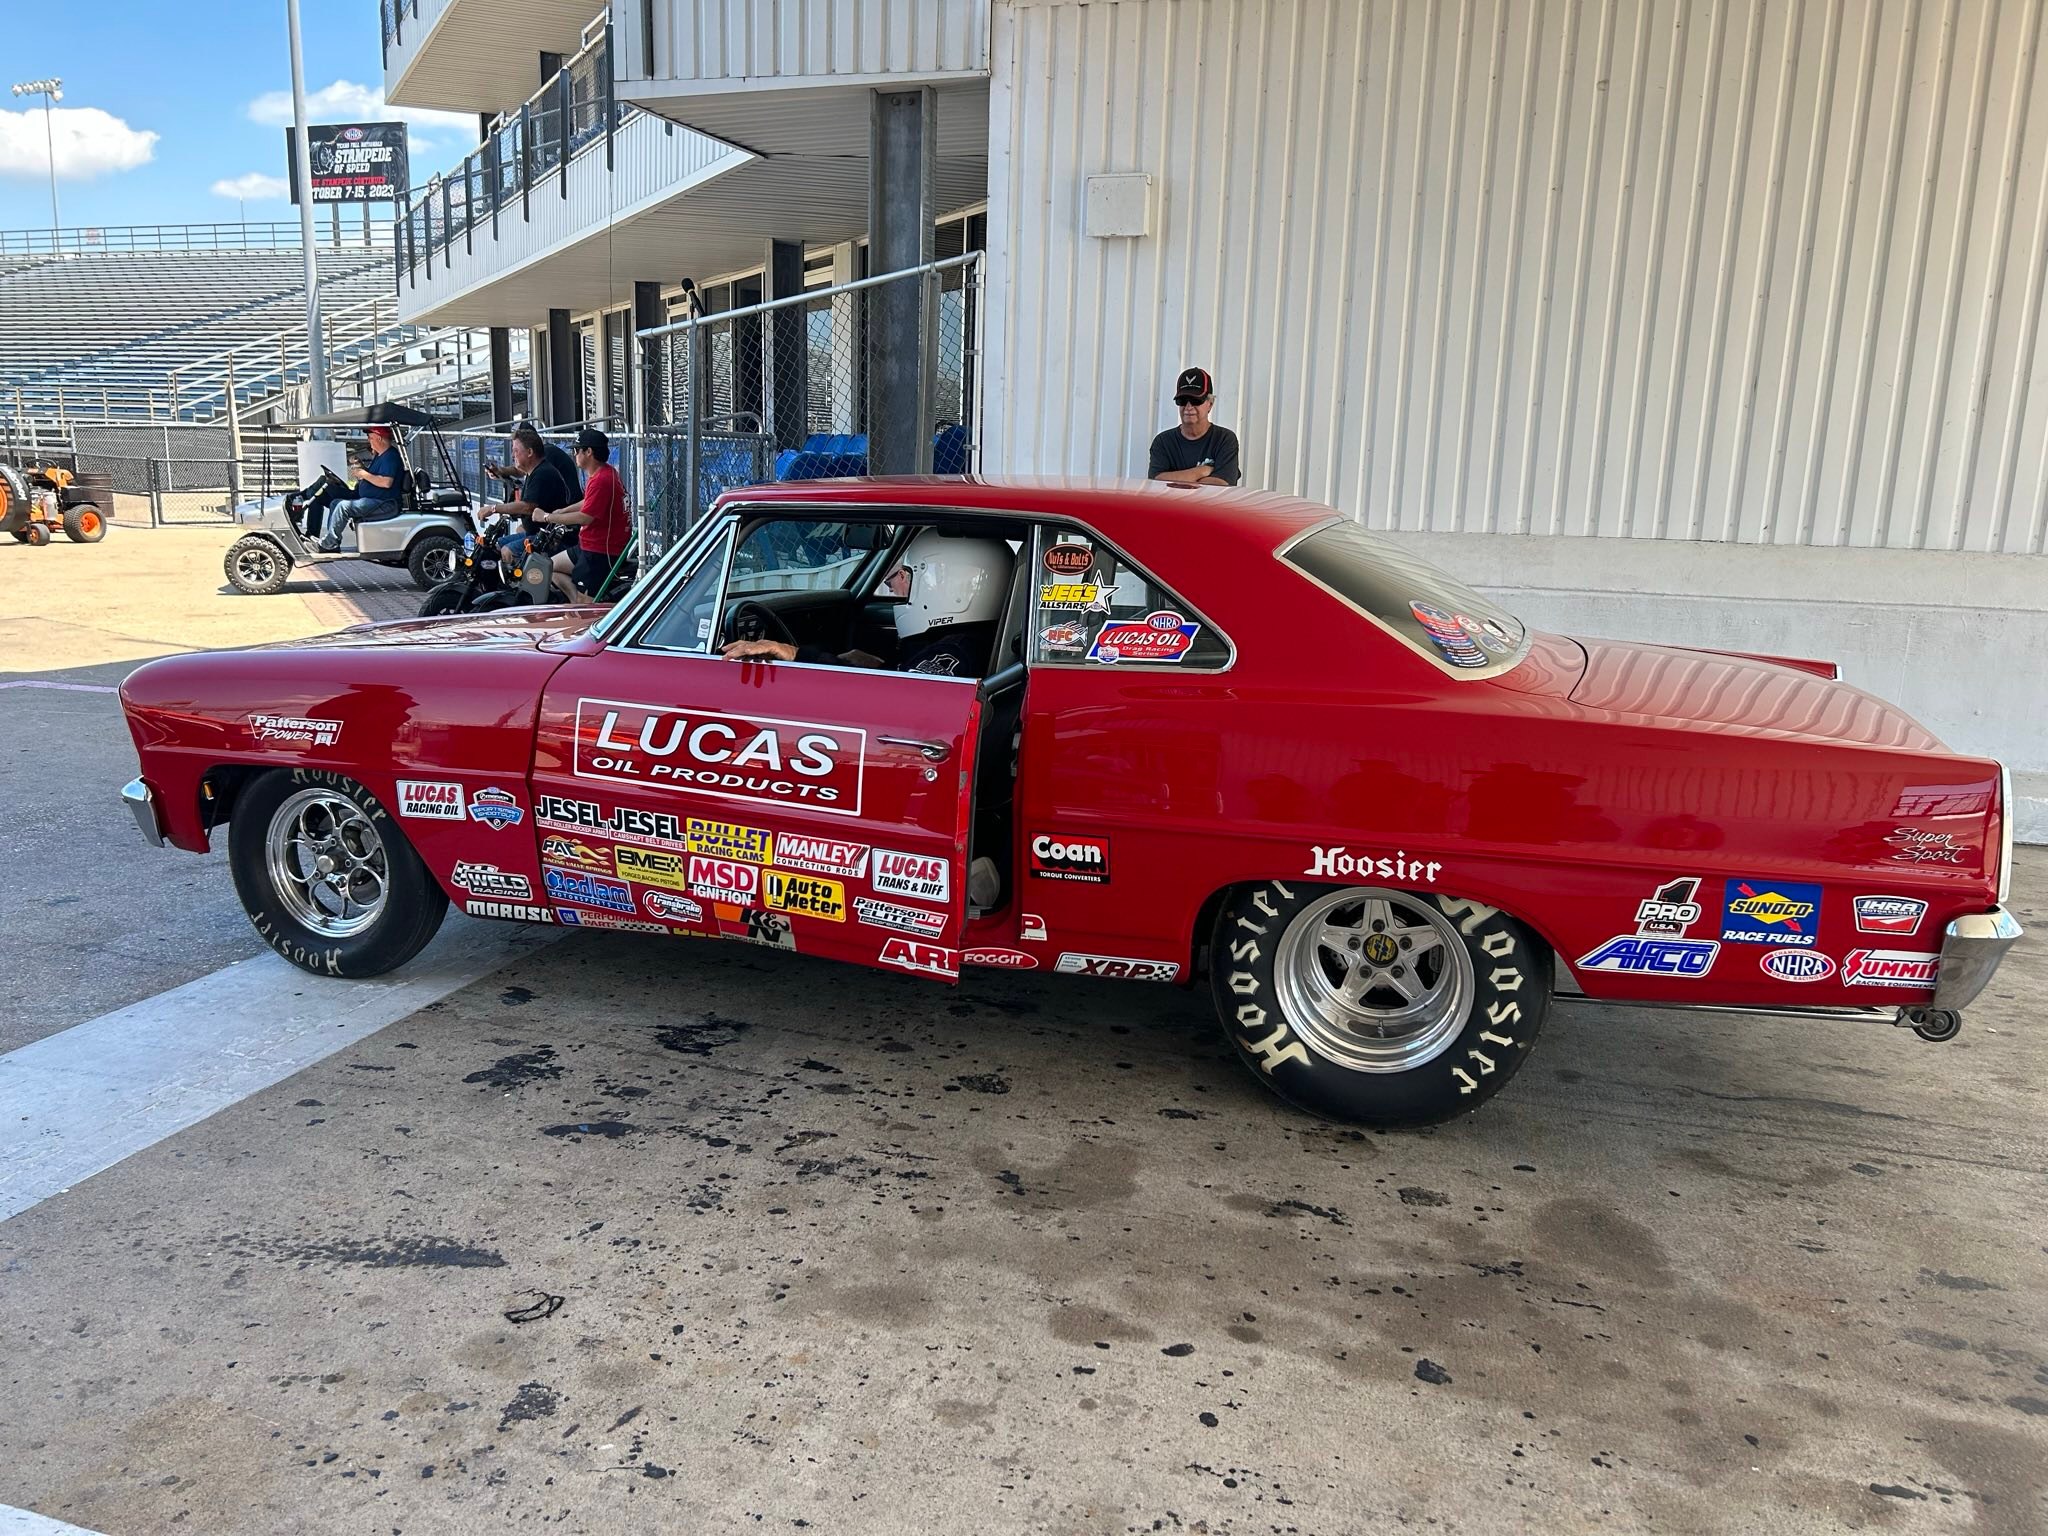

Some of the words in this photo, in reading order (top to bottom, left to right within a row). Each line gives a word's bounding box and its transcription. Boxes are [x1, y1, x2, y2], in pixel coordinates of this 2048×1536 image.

[335, 147, 392, 164] STAMPEDE
[334, 164, 344, 174] OF
[346, 163, 370, 174] SPEED
[312, 186, 342, 200] TOBER
[369, 184, 394, 198] 2023
[1042, 584, 1098, 602] JEG'S
[1040, 602, 1086, 610] ALLSTARS
[928, 616, 954, 626] VIPER
[1152, 617, 1177, 628] NHRA
[1048, 630, 1073, 641] RFC
[1104, 632, 1158, 645] LUCAS
[1156, 634, 1182, 646] OIL
[254, 716, 338, 732] Patterson
[596, 711, 840, 777] LUCAS
[591, 756, 641, 775] OIL
[650, 764, 840, 801] PRODUCTS
[404, 784, 458, 804] LUCAS
[406, 802, 442, 815] RACING
[444, 804, 459, 816] OIL
[536, 796, 603, 828] JESEL
[610, 808, 681, 841] JESEL
[614, 832, 644, 842] CAMSHAFT
[645, 836, 660, 844] BELT
[662, 840, 683, 849] DRIVES
[690, 821, 770, 852] BULLET
[1883, 828, 1954, 850] Super
[543, 840, 580, 858] PAC
[696, 844, 733, 858] RACING
[736, 850, 764, 862] CAMS
[778, 836, 857, 864] MANLEY
[1032, 836, 1102, 863] Coan
[1892, 846, 1971, 864] Sport
[617, 848, 671, 872] BME
[776, 858, 832, 872] CONNECTING
[836, 867, 860, 876] RODS
[880, 854, 942, 881] LUCAS
[1304, 846, 1442, 883] Hoosier
[467, 873, 528, 890] WELD
[692, 859, 754, 892] MSD
[1064, 874, 1102, 882] CONVERTERS
[473, 888, 528, 896] RACING
[546, 870, 631, 904] Bedlam
[786, 878, 832, 898] Auto
[878, 876, 910, 890] TRANS
[910, 882, 918, 892] &
[920, 884, 944, 896] DIFF
[551, 891, 612, 908] MOTORSPORTS
[616, 904, 632, 912] LLC
[653, 895, 700, 912] Transbrake
[692, 885, 752, 906] IGNITION
[785, 892, 842, 914] Meter
[855, 898, 926, 920] Patterson
[1640, 903, 1698, 920] PRO
[1733, 900, 1809, 916] SUNOCO
[1862, 900, 1917, 911] IHRA
[584, 920, 618, 928] PARTS
[860, 908, 914, 926] ELITE
[1722, 930, 1767, 942] RACE
[1767, 932, 1814, 945] FUELS
[964, 954, 1024, 964] FOGGIT
[1582, 940, 1715, 974] AFCO
[1774, 950, 1824, 959] CHAMPIONSHIP
[1077, 958, 1156, 978] XRP
[1772, 955, 1824, 975] NHRA
[1772, 972, 1790, 980] DRAG
